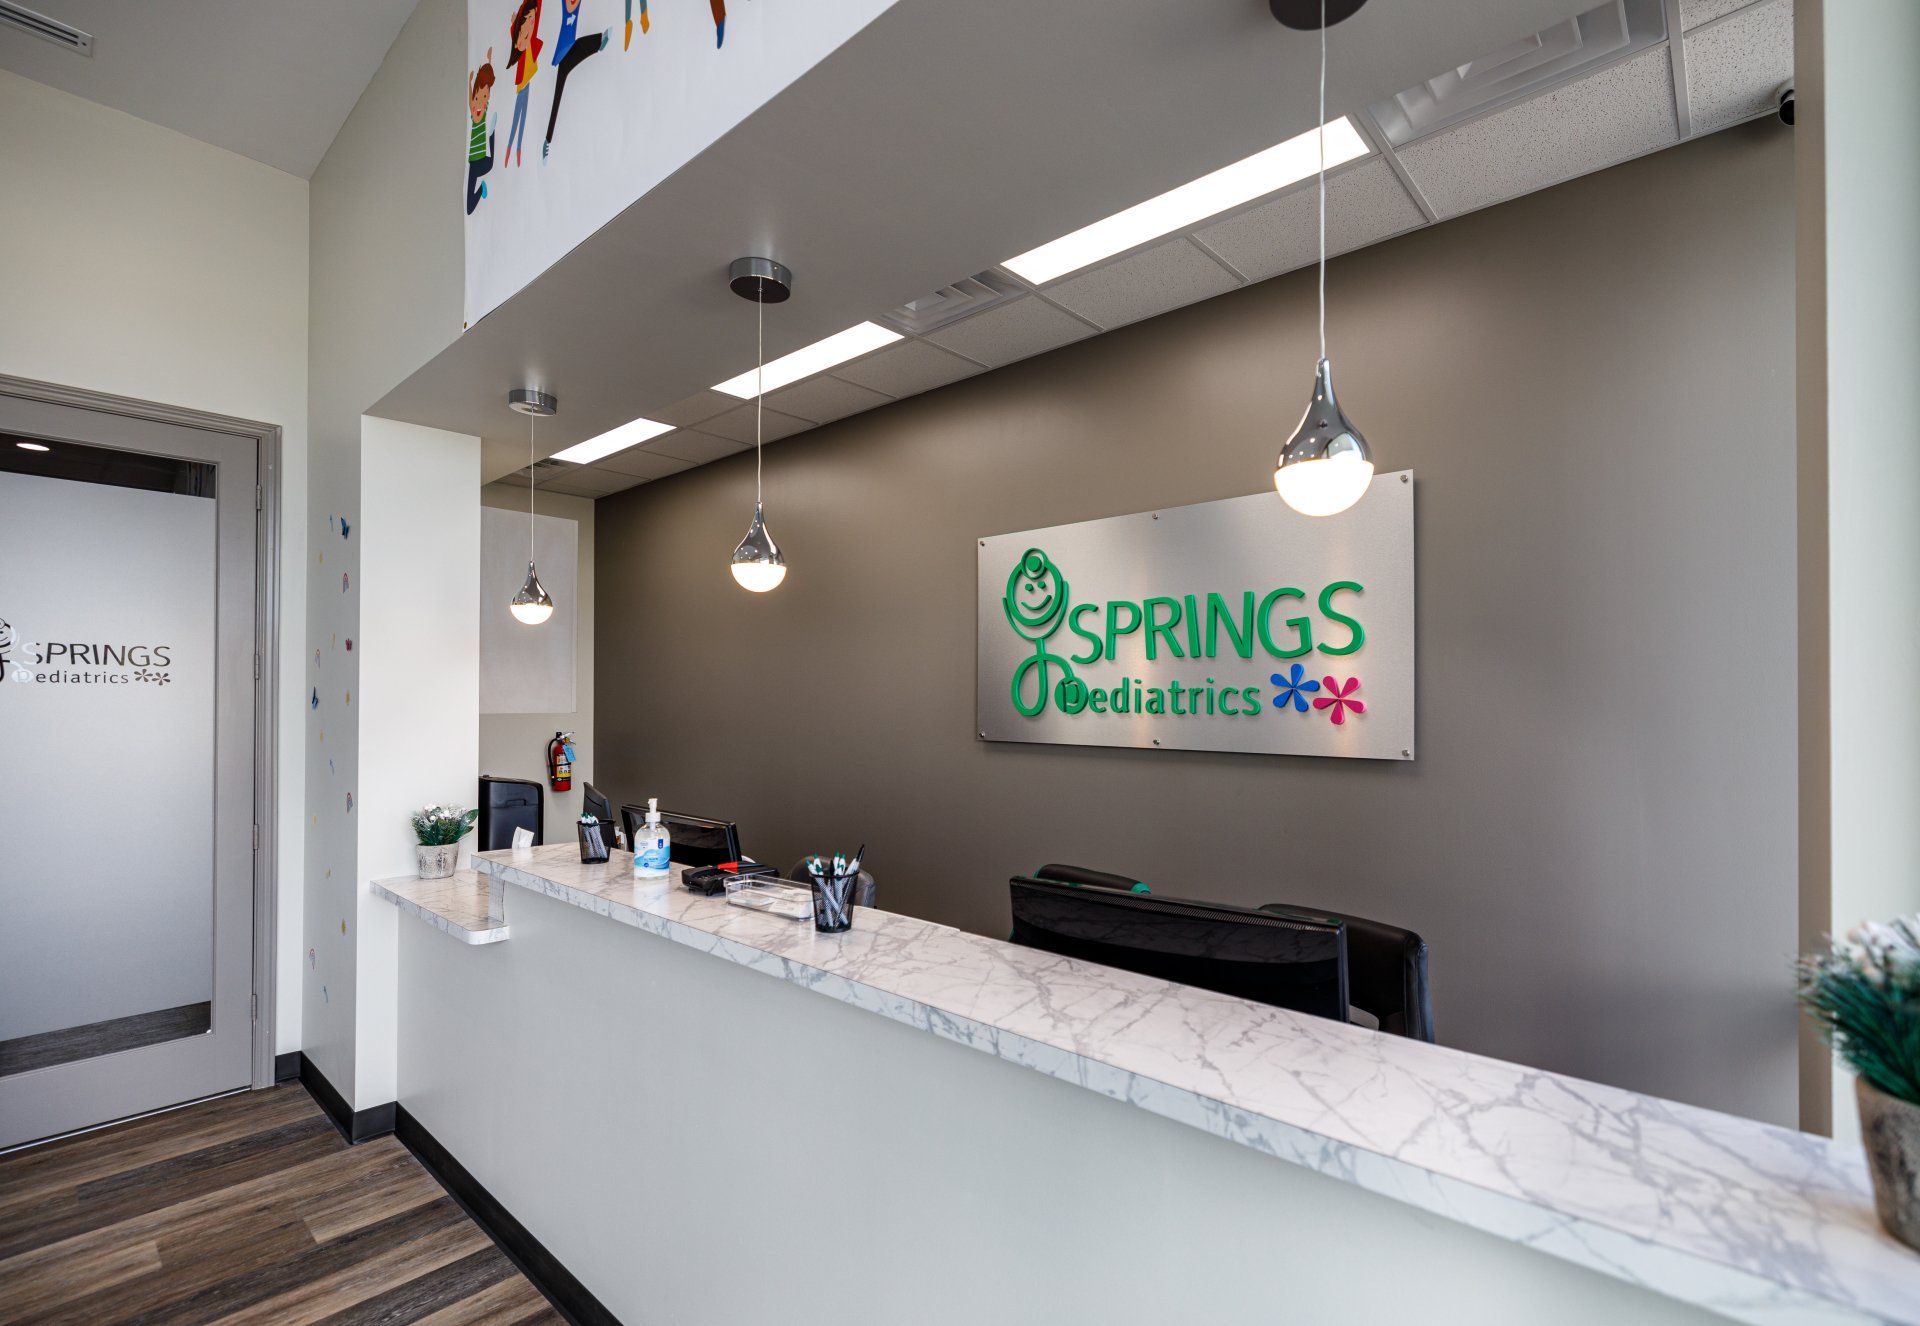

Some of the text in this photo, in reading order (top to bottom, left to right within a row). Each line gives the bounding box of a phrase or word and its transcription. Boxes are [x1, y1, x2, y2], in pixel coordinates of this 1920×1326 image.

[1068, 580, 1366, 665] SPRINGS
[21, 641, 171, 667] SPRINGS
[16, 669, 129, 684] Pediatrics
[1058, 675, 1262, 716] Pediatrics
